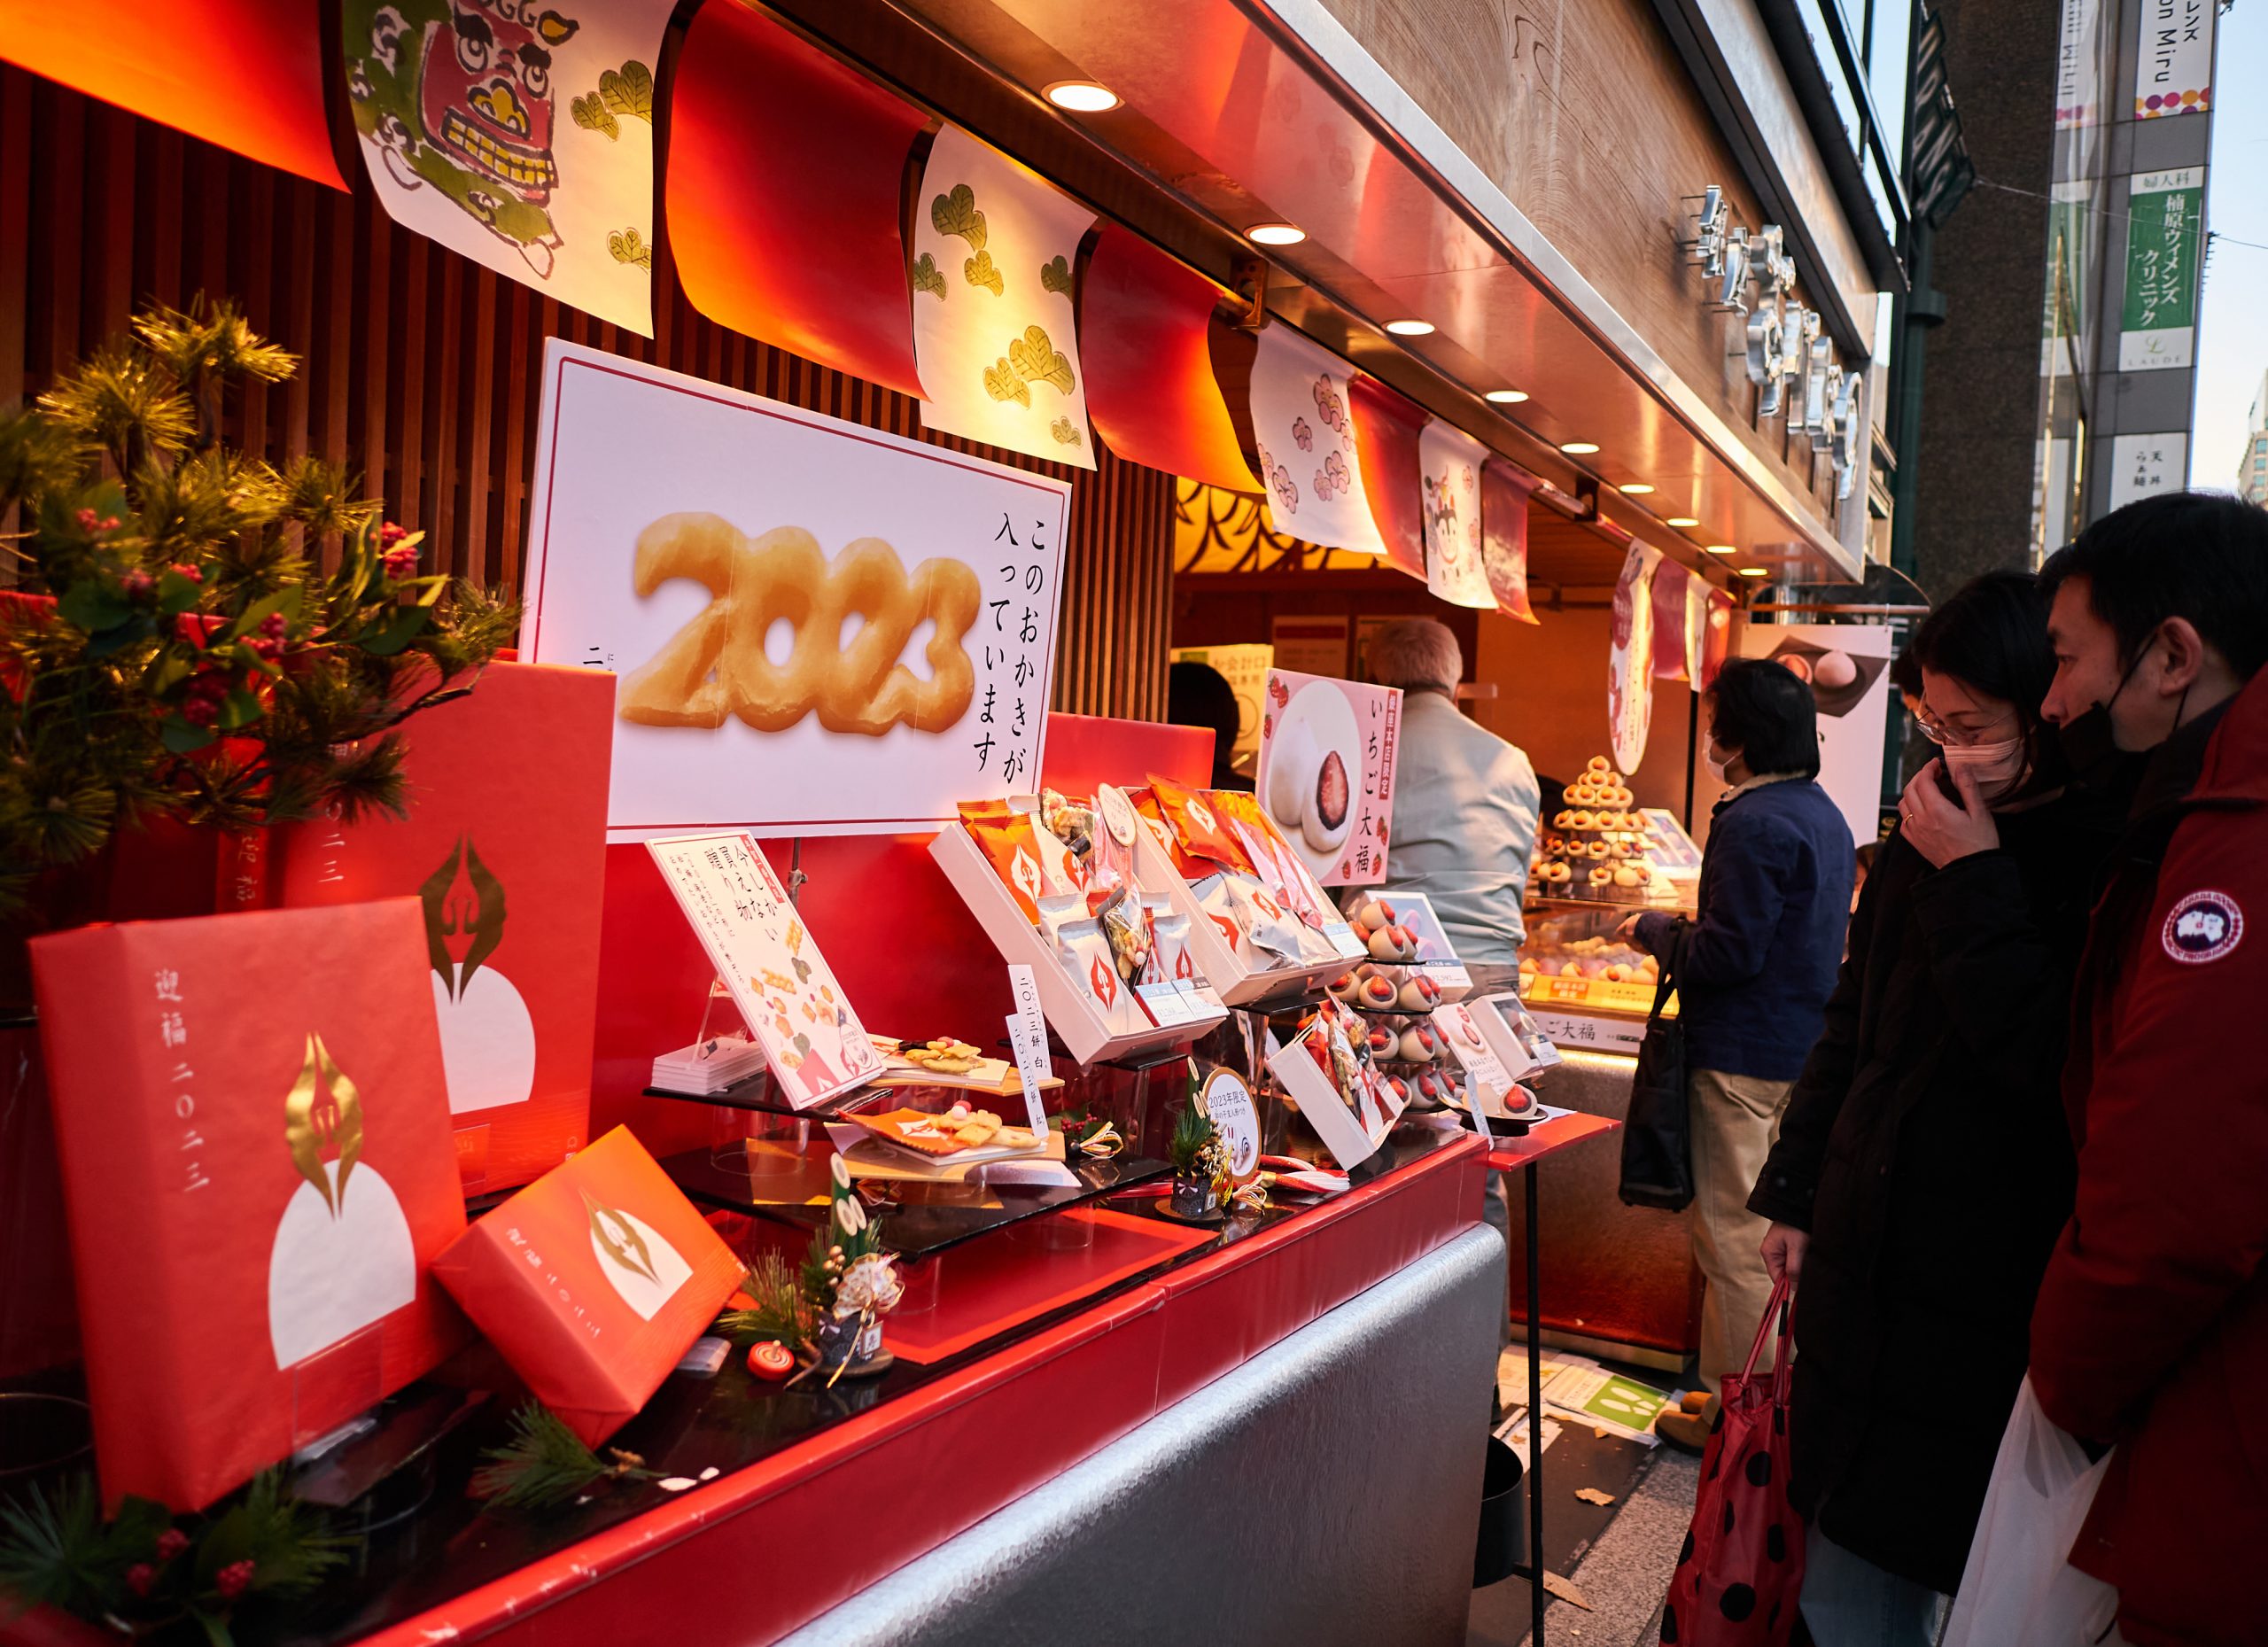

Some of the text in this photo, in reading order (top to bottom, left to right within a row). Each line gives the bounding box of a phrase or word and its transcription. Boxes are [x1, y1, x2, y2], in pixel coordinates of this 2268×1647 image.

[2155, 28, 2177, 82] Miru
[2139, 249, 2159, 327] クリニック
[974, 511, 1019, 773] 入っています
[1004, 519, 1045, 785] このおかきが
[1355, 698, 1383, 874] いちご大福
[704, 847, 754, 921] 贈り物
[718, 845, 779, 942] 買えない
[734, 844, 779, 917] 今しか
[1532, 1017, 1596, 1041] ご大福
[154, 967, 210, 1193] 迎福二〇二三
[1208, 1090, 1247, 1108] 2023年限定
